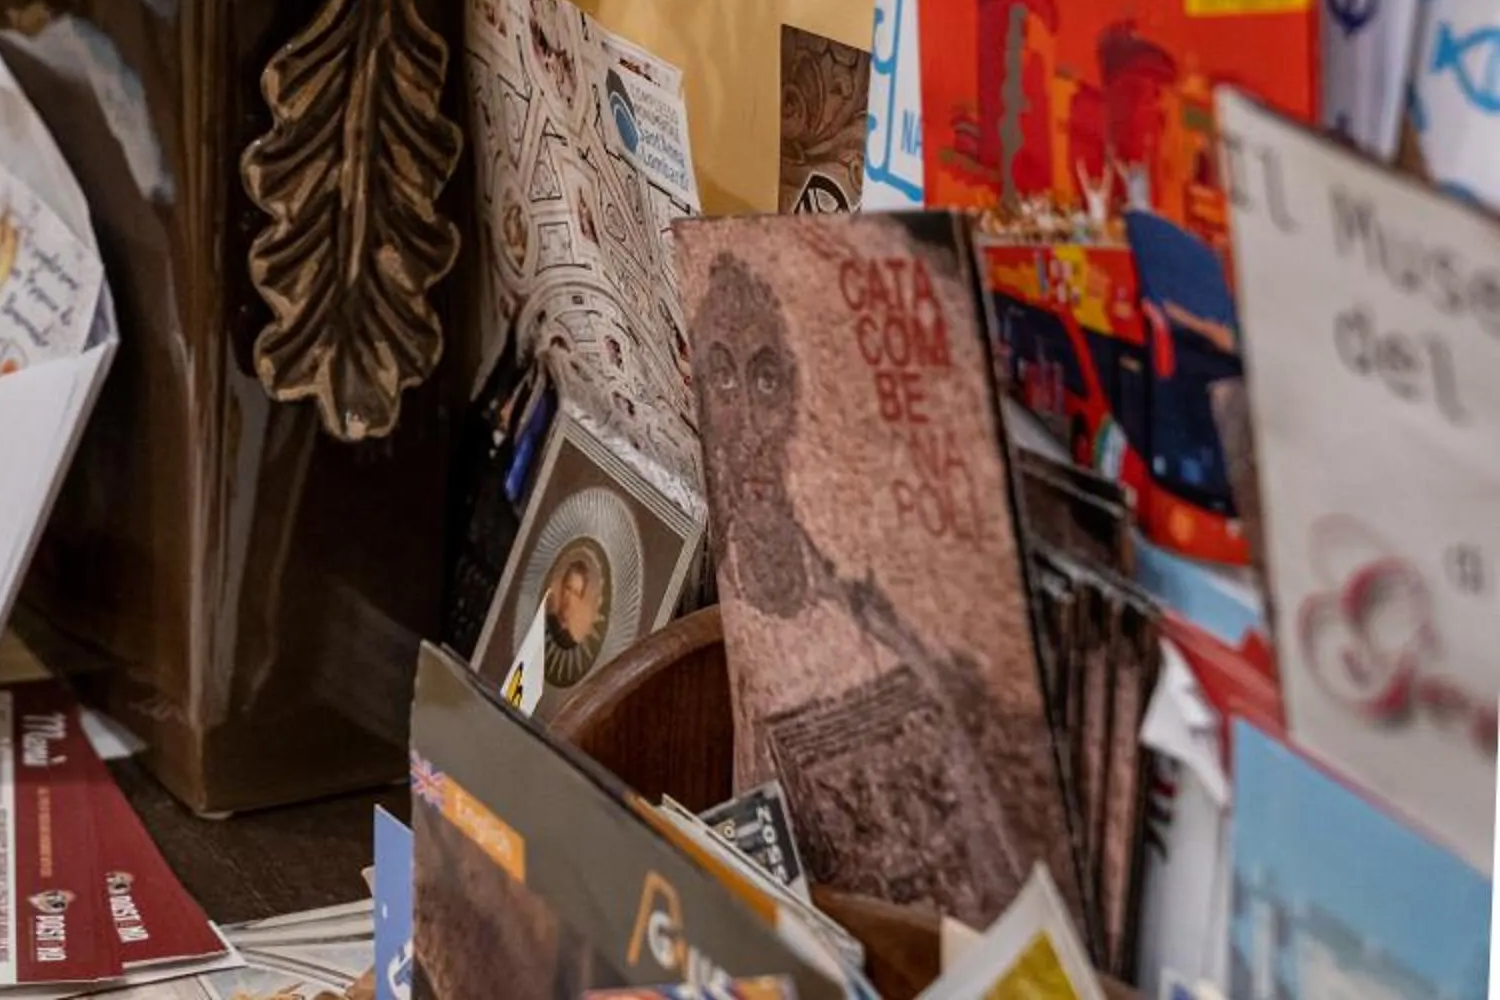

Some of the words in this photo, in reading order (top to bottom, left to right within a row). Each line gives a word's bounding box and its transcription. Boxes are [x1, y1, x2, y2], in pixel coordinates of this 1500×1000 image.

[838, 257, 940, 312] CATA
[856, 312, 952, 370] COM
[875, 371, 930, 425] BE
